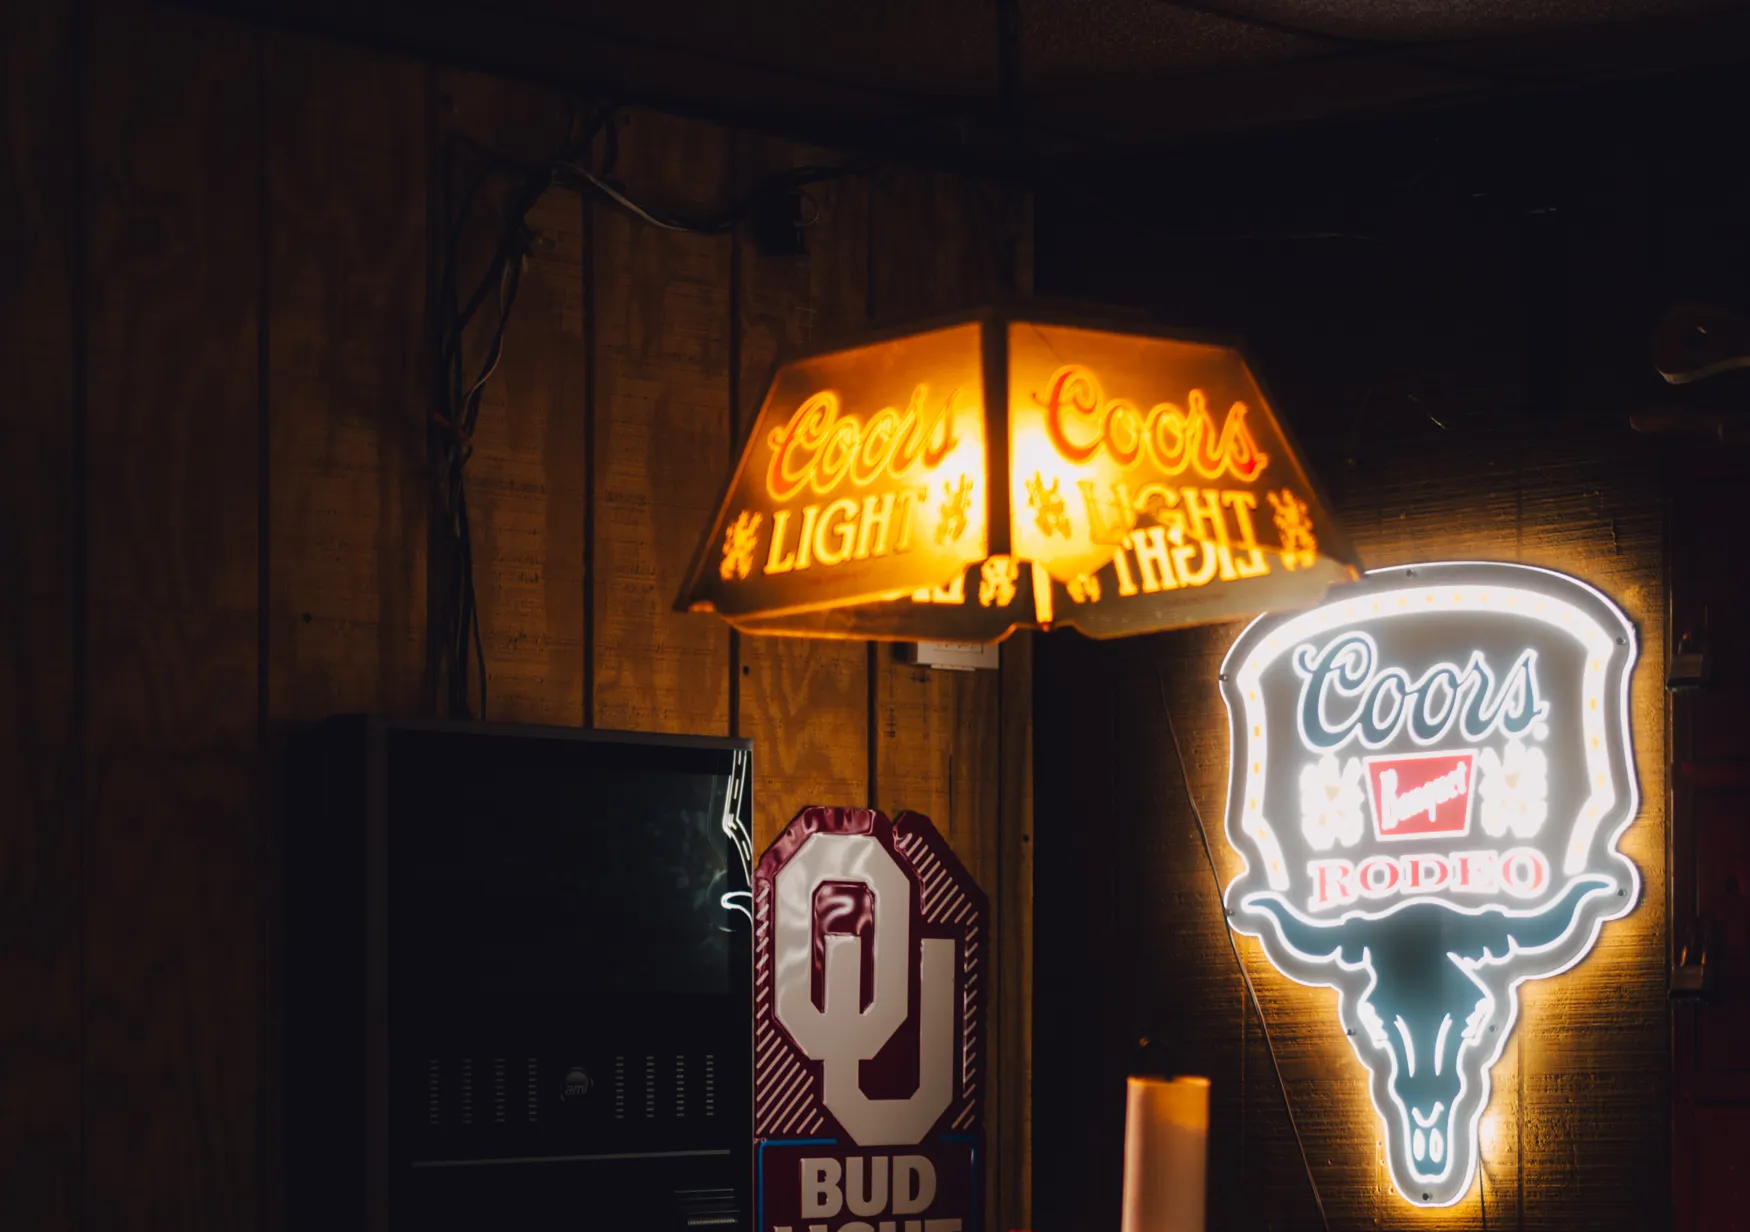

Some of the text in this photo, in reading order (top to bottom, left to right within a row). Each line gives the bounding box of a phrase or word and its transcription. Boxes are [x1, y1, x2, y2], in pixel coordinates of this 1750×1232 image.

[767, 388, 962, 500] Coors
[1032, 364, 1268, 482] Coors
[764, 486, 927, 576] LIGHT
[1077, 486, 1258, 553] LIGHT
[1293, 630, 1550, 753] Coors
[1308, 848, 1550, 911] RODEO
[800, 1155, 937, 1219] BUD
